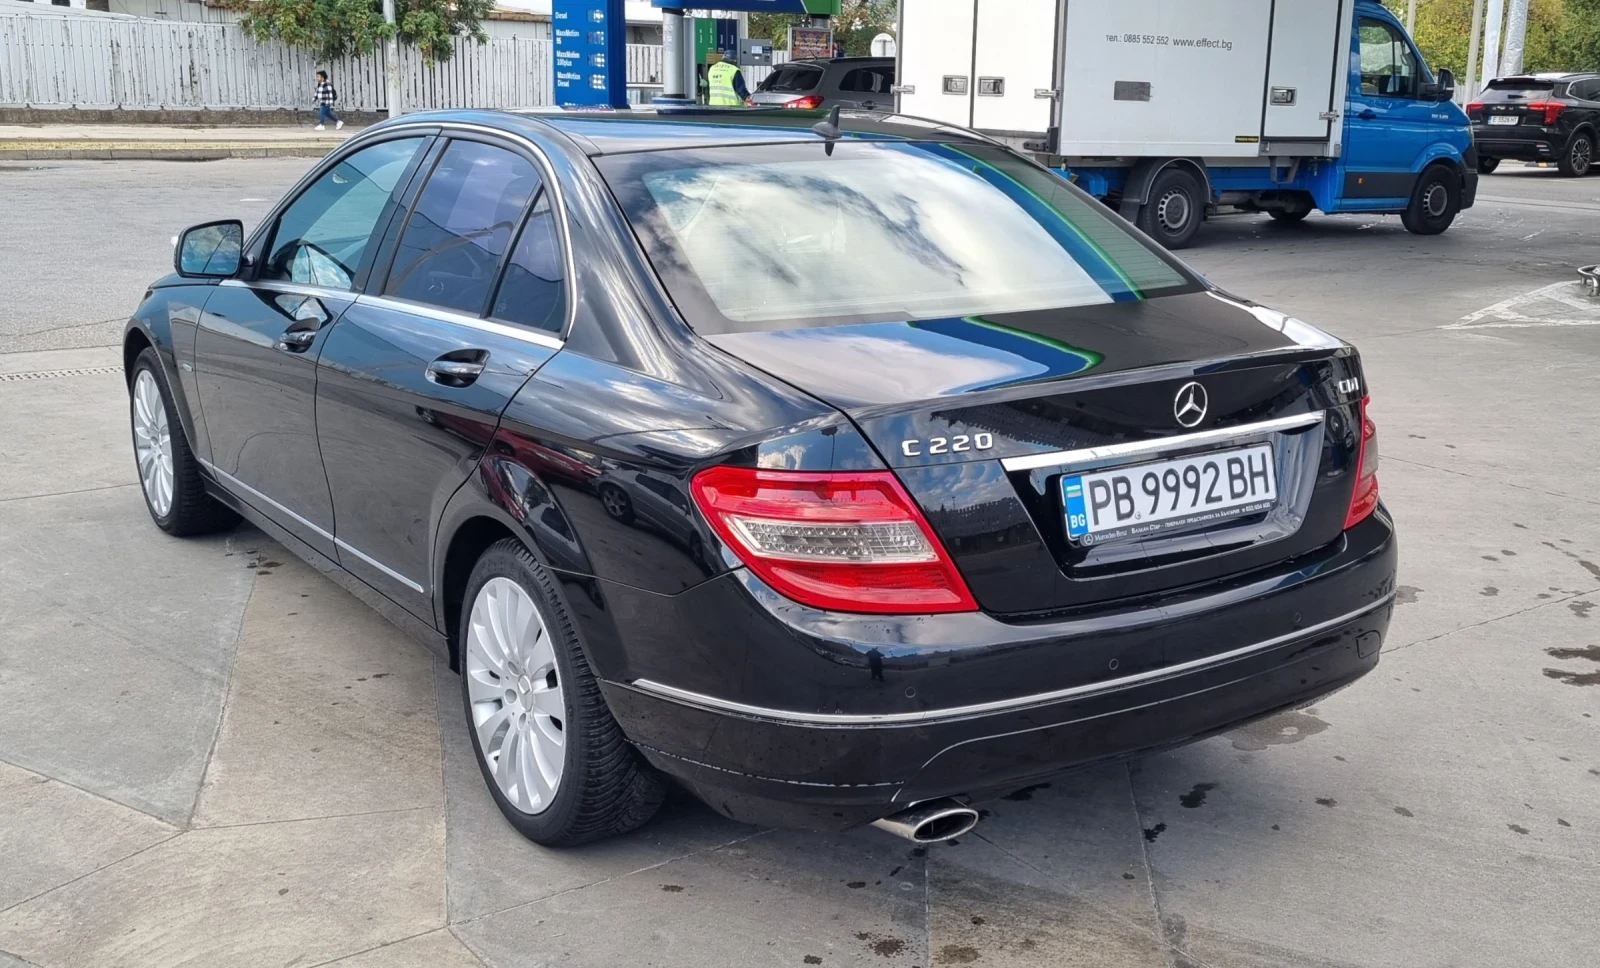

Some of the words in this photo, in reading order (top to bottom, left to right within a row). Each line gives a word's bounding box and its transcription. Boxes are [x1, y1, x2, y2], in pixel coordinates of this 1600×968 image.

[555, 11, 568, 19] Diesel
[1123, 34, 1141, 44] 0885
[1142, 35, 1155, 44] 552
[1156, 36, 1169, 45] 552
[1173, 37, 1233, 51] www.effect.bg
[557, 80, 570, 88] Diesel
[901, 439, 921, 456] C
[929, 432, 993, 455] 220
[1089, 476, 1135, 526] PB
[1141, 460, 1223, 515] 9992
[1226, 452, 1270, 500] BH
[1070, 513, 1086, 528] BG
